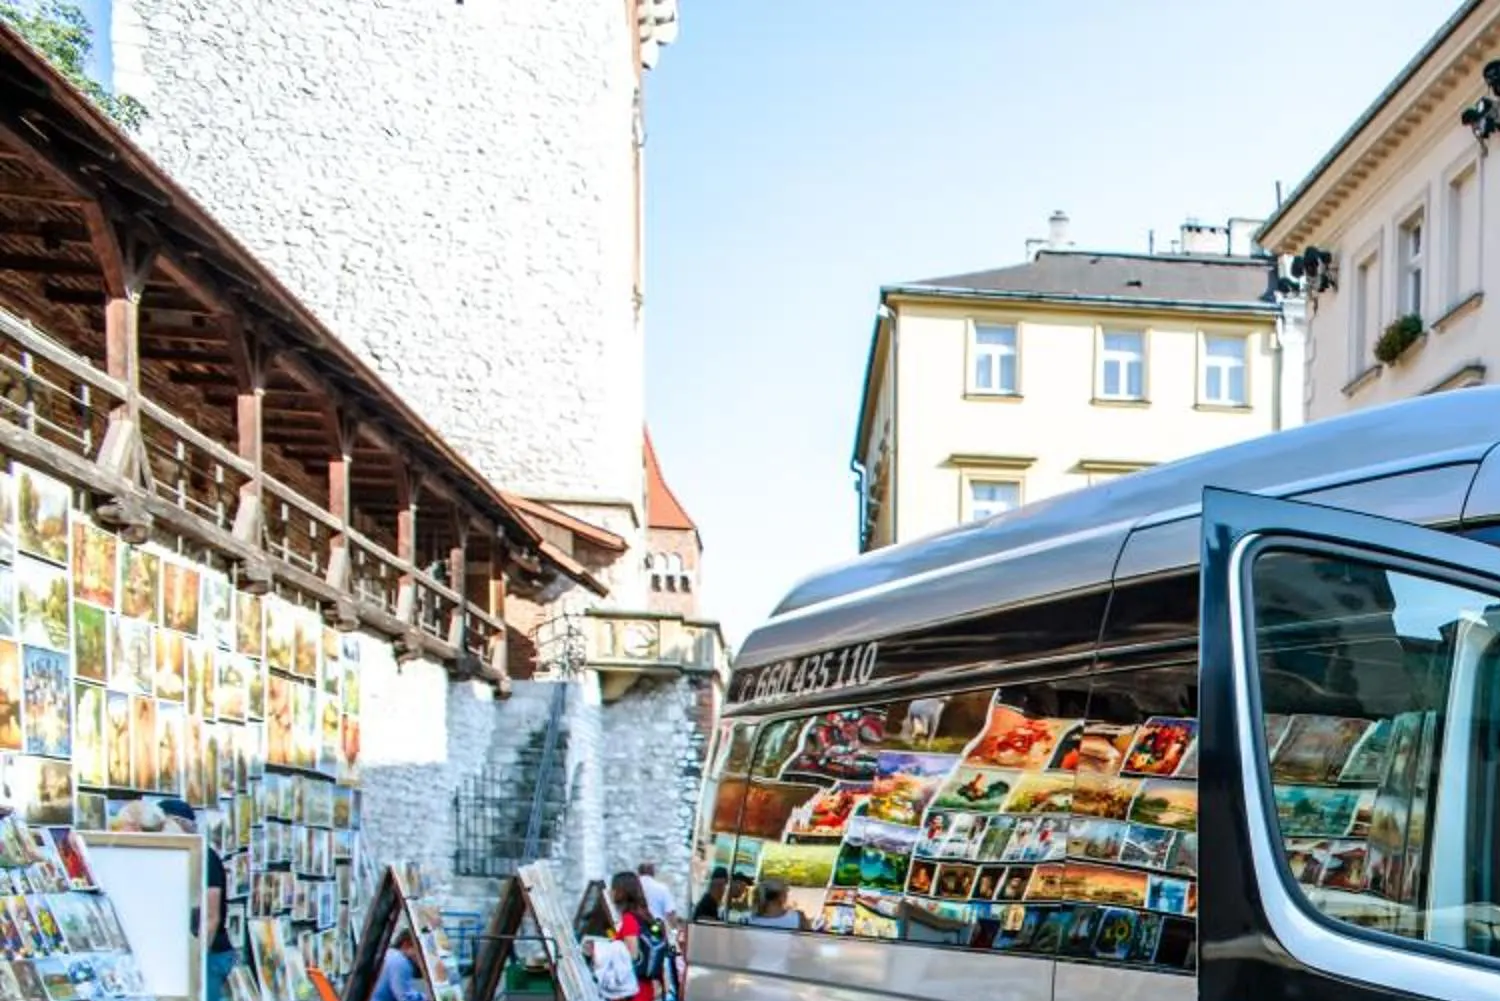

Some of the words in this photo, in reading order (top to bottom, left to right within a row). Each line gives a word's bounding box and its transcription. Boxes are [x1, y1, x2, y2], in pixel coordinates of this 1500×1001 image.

[754, 661, 794, 703] 660
[791, 652, 834, 696] 435
[832, 641, 878, 689] 110
